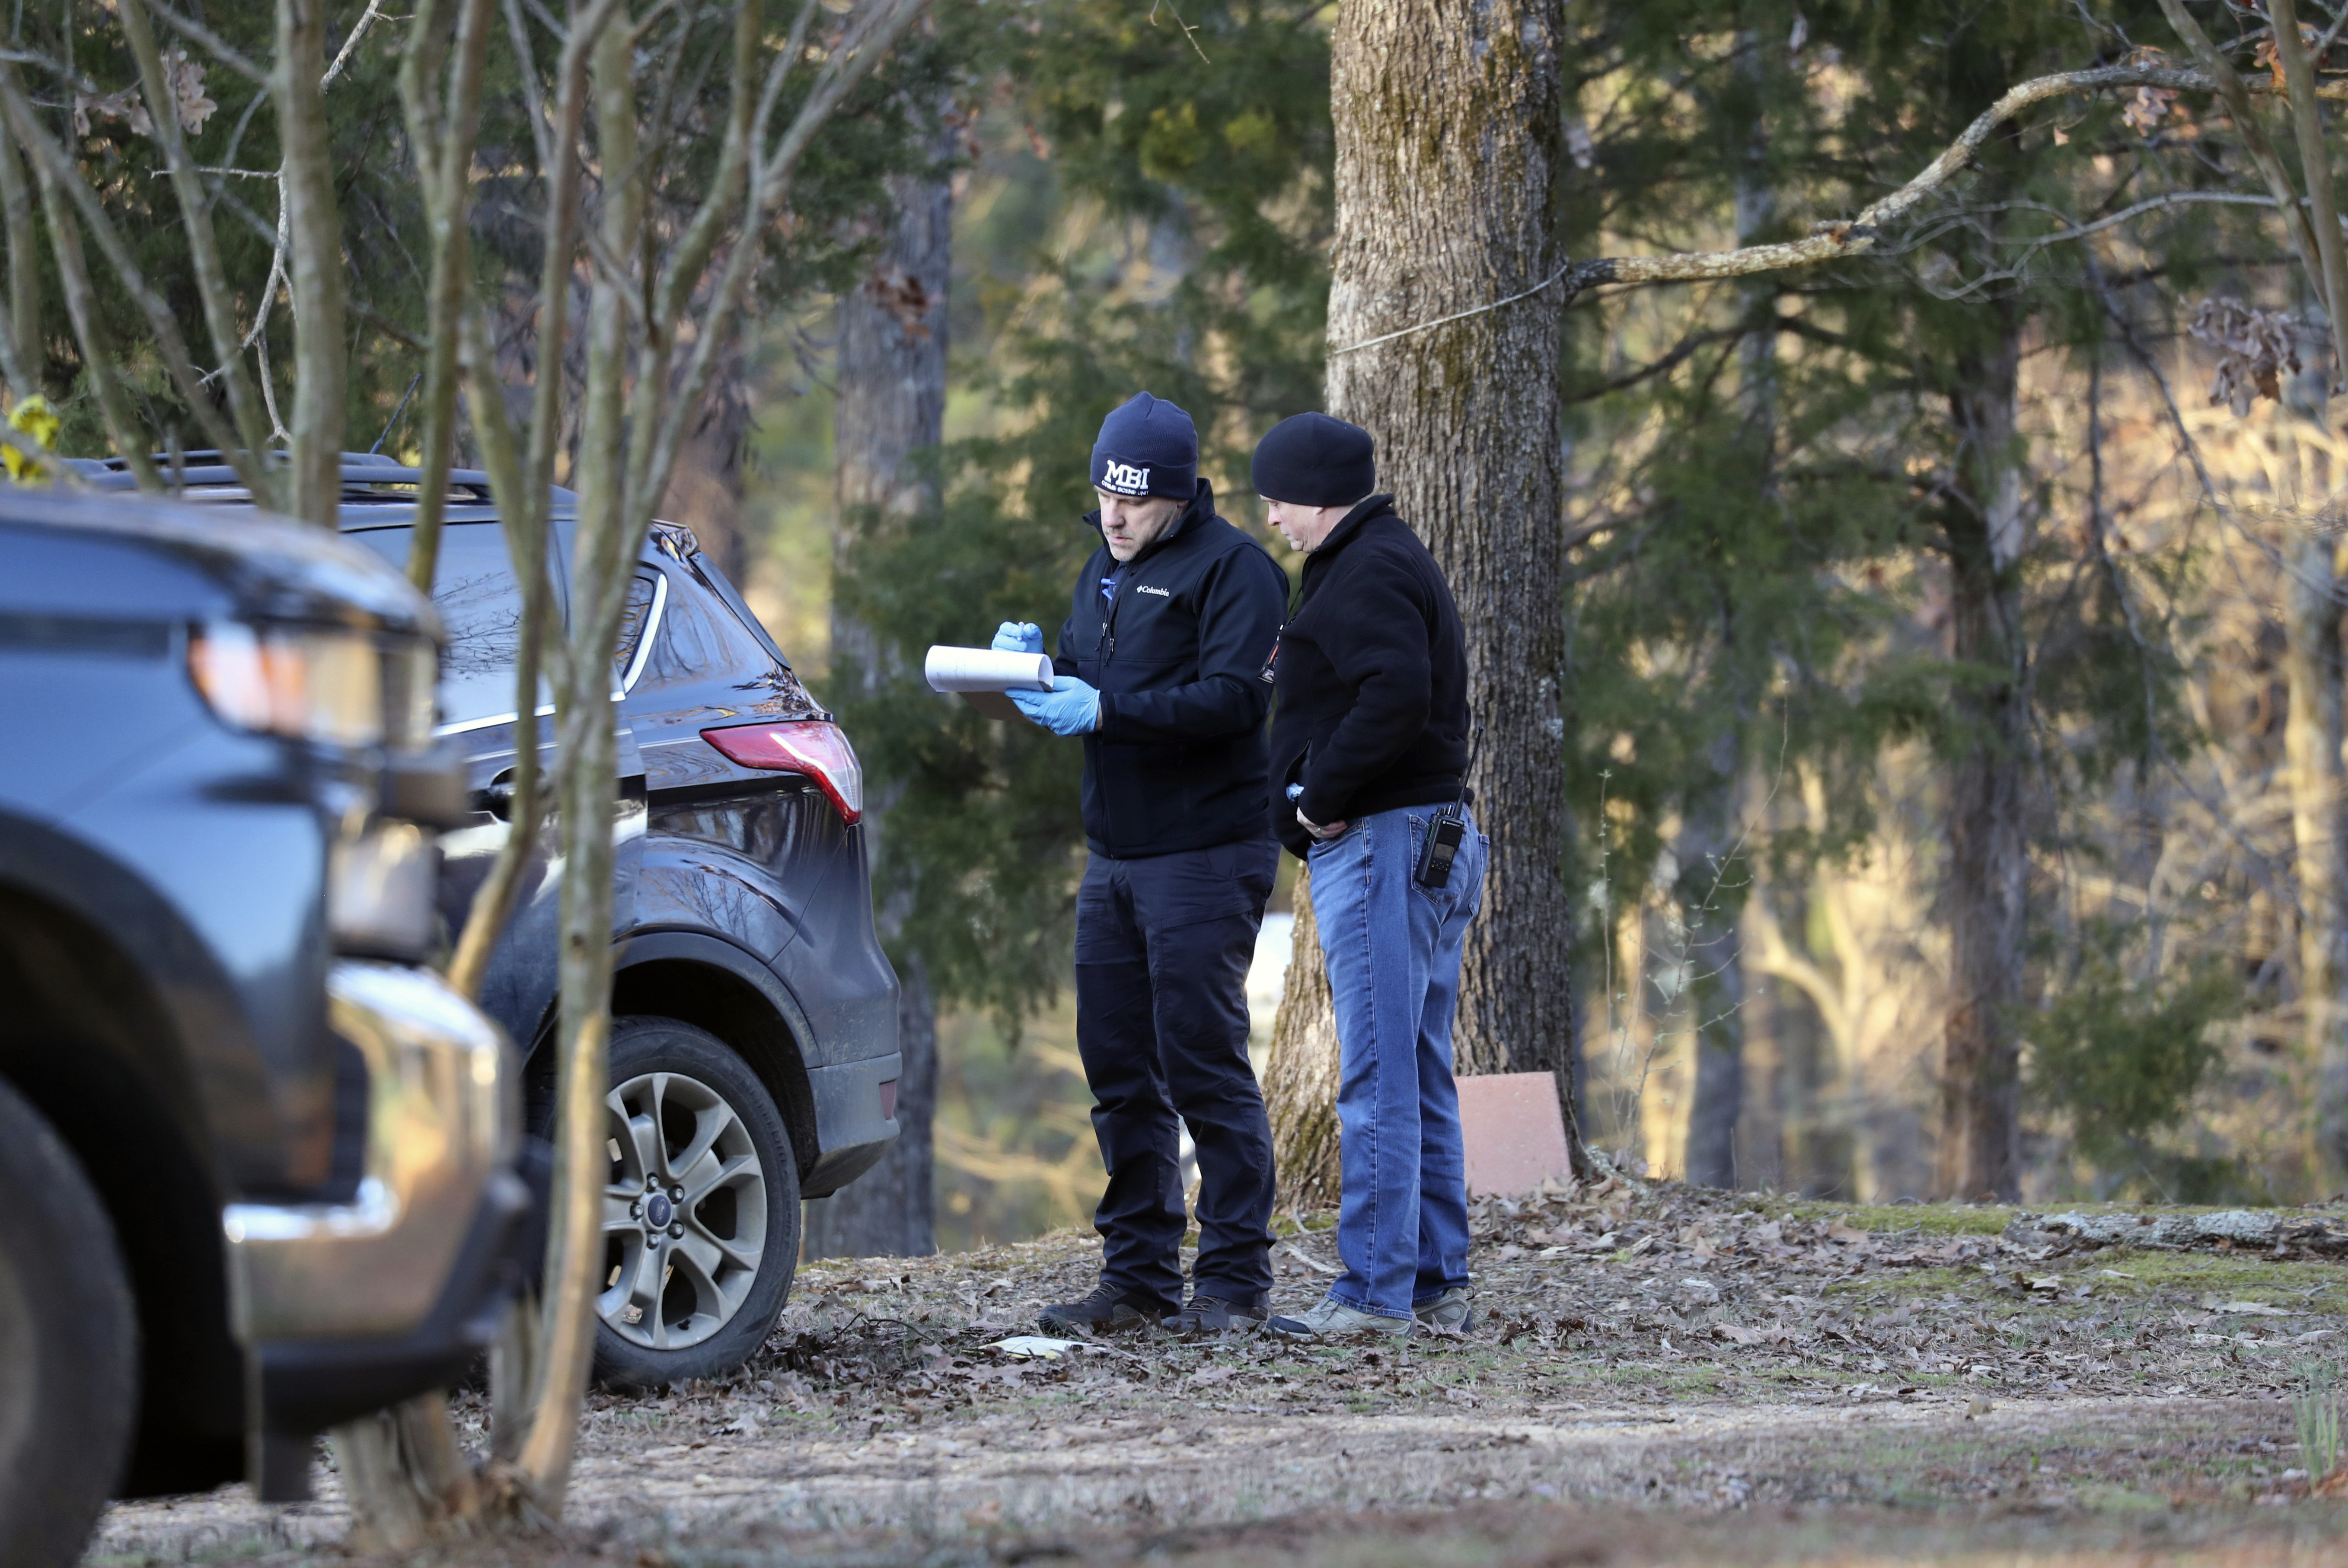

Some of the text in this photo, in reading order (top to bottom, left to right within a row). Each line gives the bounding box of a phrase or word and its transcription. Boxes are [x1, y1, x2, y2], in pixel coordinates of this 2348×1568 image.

[1104, 459, 1150, 489] MBI
[1117, 486, 1137, 495] SCENE
[1142, 586, 1169, 597] Columbia
